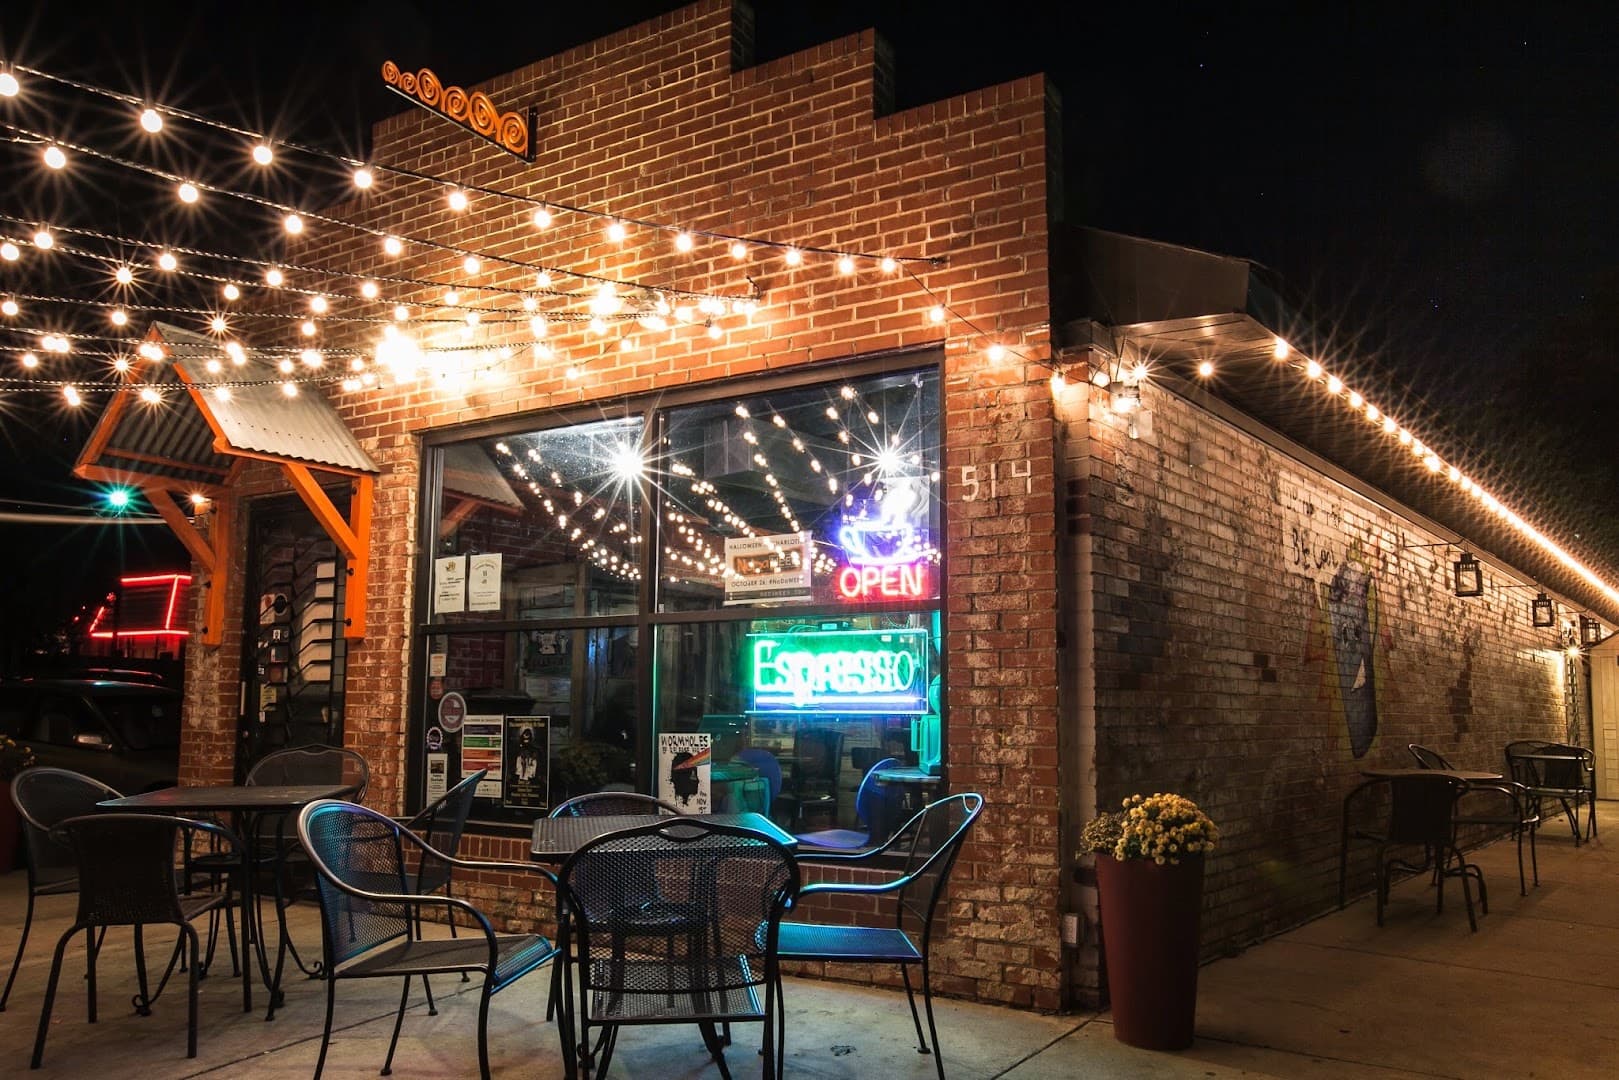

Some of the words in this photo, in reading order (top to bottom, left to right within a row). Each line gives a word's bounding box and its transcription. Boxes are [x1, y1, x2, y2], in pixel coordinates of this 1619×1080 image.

[961, 460, 1032, 502] 514
[840, 563, 923, 599] OPEN
[661, 735, 708, 748] WORMHOLES
